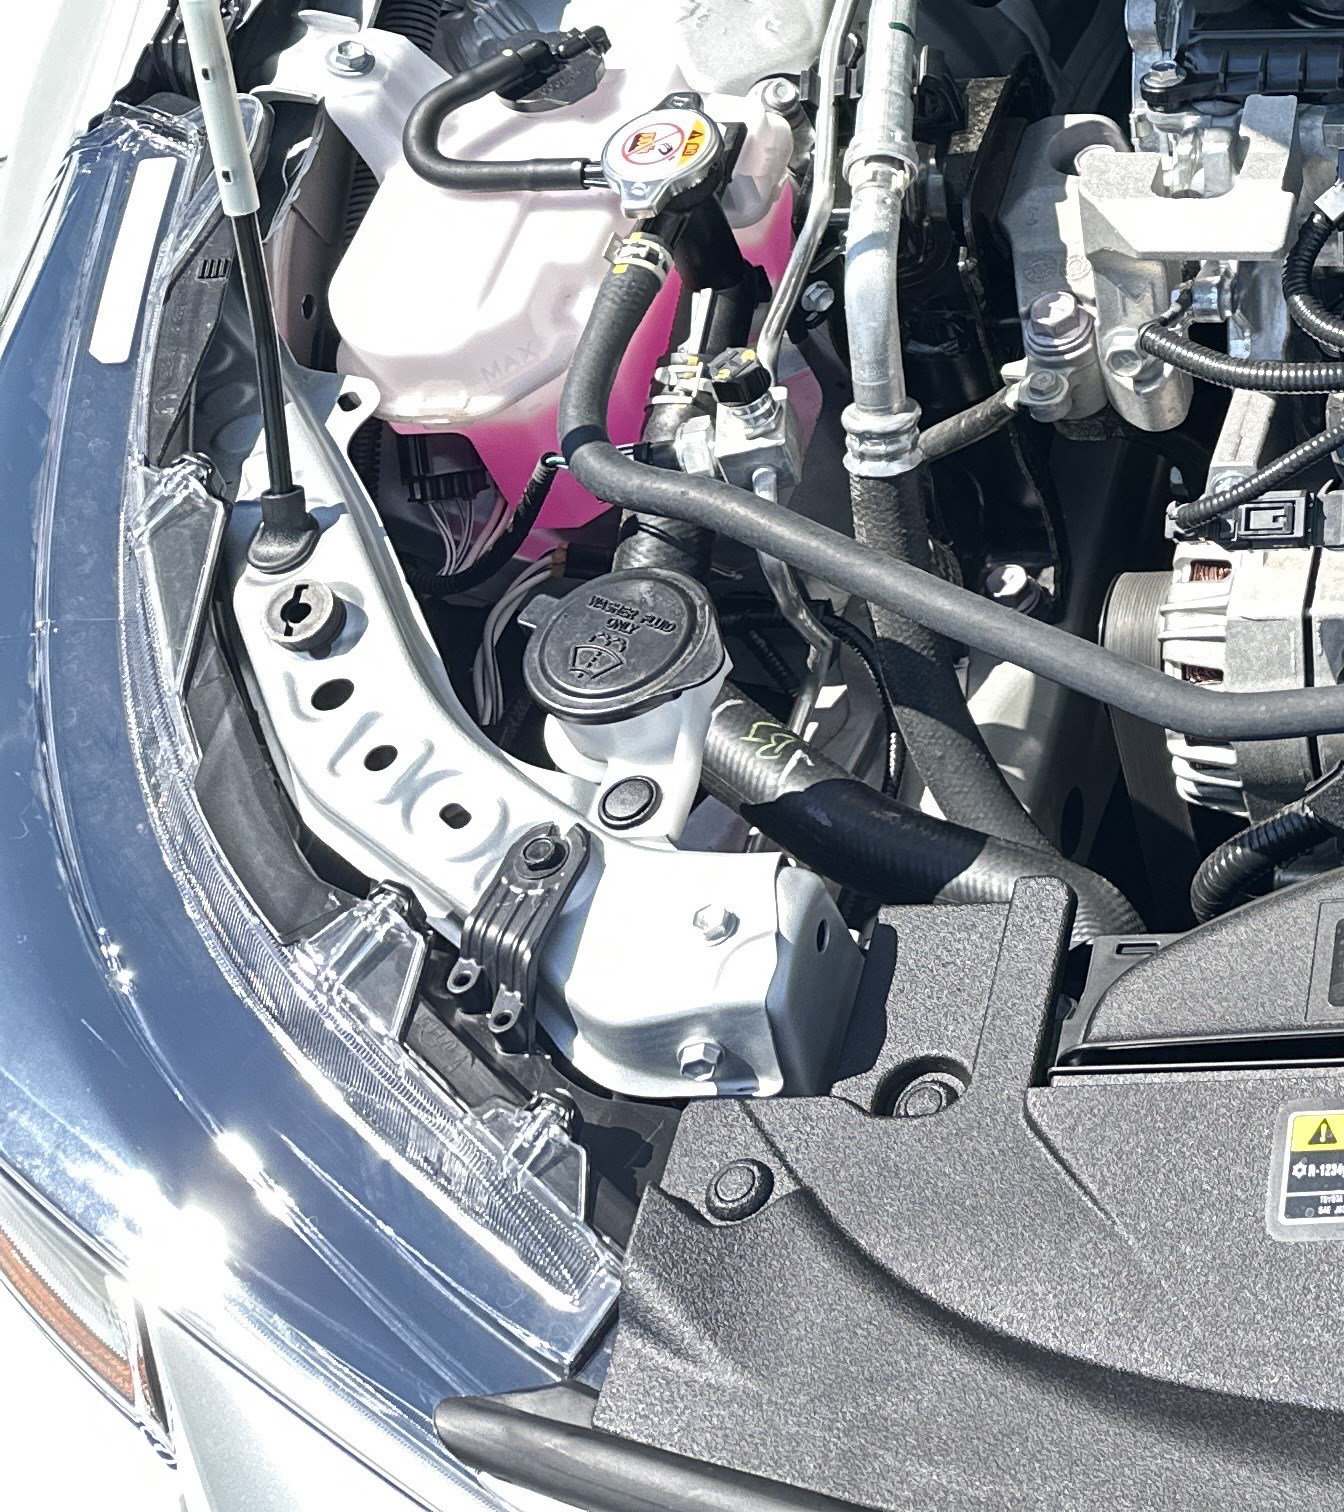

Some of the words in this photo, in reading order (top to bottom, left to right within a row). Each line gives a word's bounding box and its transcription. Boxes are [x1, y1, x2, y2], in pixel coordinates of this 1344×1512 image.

[480, 340, 539, 383] MAX
[588, 595, 640, 621] WASHER
[641, 613, 677, 633] FLUID
[606, 618, 641, 635] ONLY
